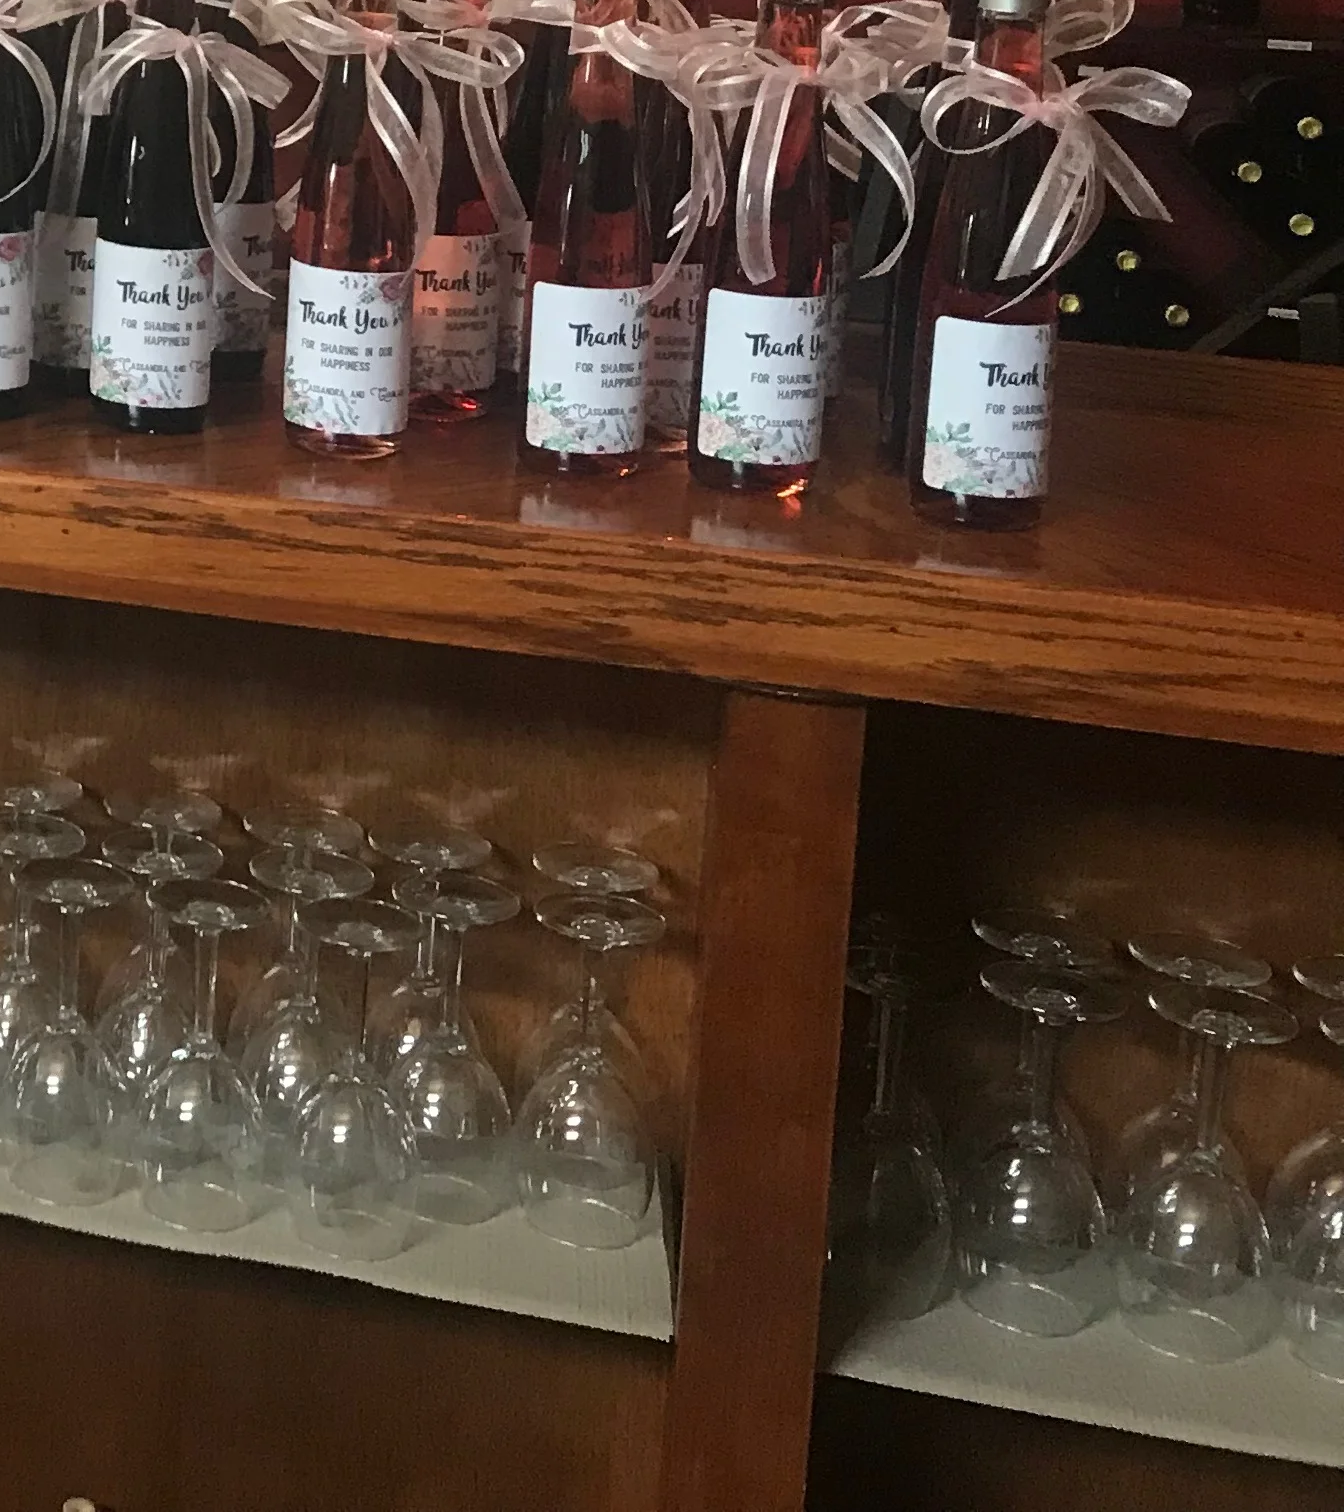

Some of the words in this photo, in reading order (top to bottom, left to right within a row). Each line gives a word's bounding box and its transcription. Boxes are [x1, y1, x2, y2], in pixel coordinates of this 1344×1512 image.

[414, 268, 471, 292] Thank
[116, 280, 171, 306] Thank
[177, 285, 204, 311] You
[121, 318, 137, 329] FOR
[144, 321, 180, 332] SHARING
[299, 298, 348, 329] Thank
[354, 306, 389, 335] You
[144, 336, 190, 347] HAPPINESS
[568, 322, 627, 347] Thank
[301, 338, 315, 350] FOR
[320, 342, 359, 357] SHARING
[745, 332, 806, 358] Thank
[320, 357, 371, 372] HAPPINESS
[575, 361, 593, 373] FOR
[751, 372, 770, 384] FOR
[979, 361, 1040, 388] Thank
[985, 403, 1006, 415] FOR
